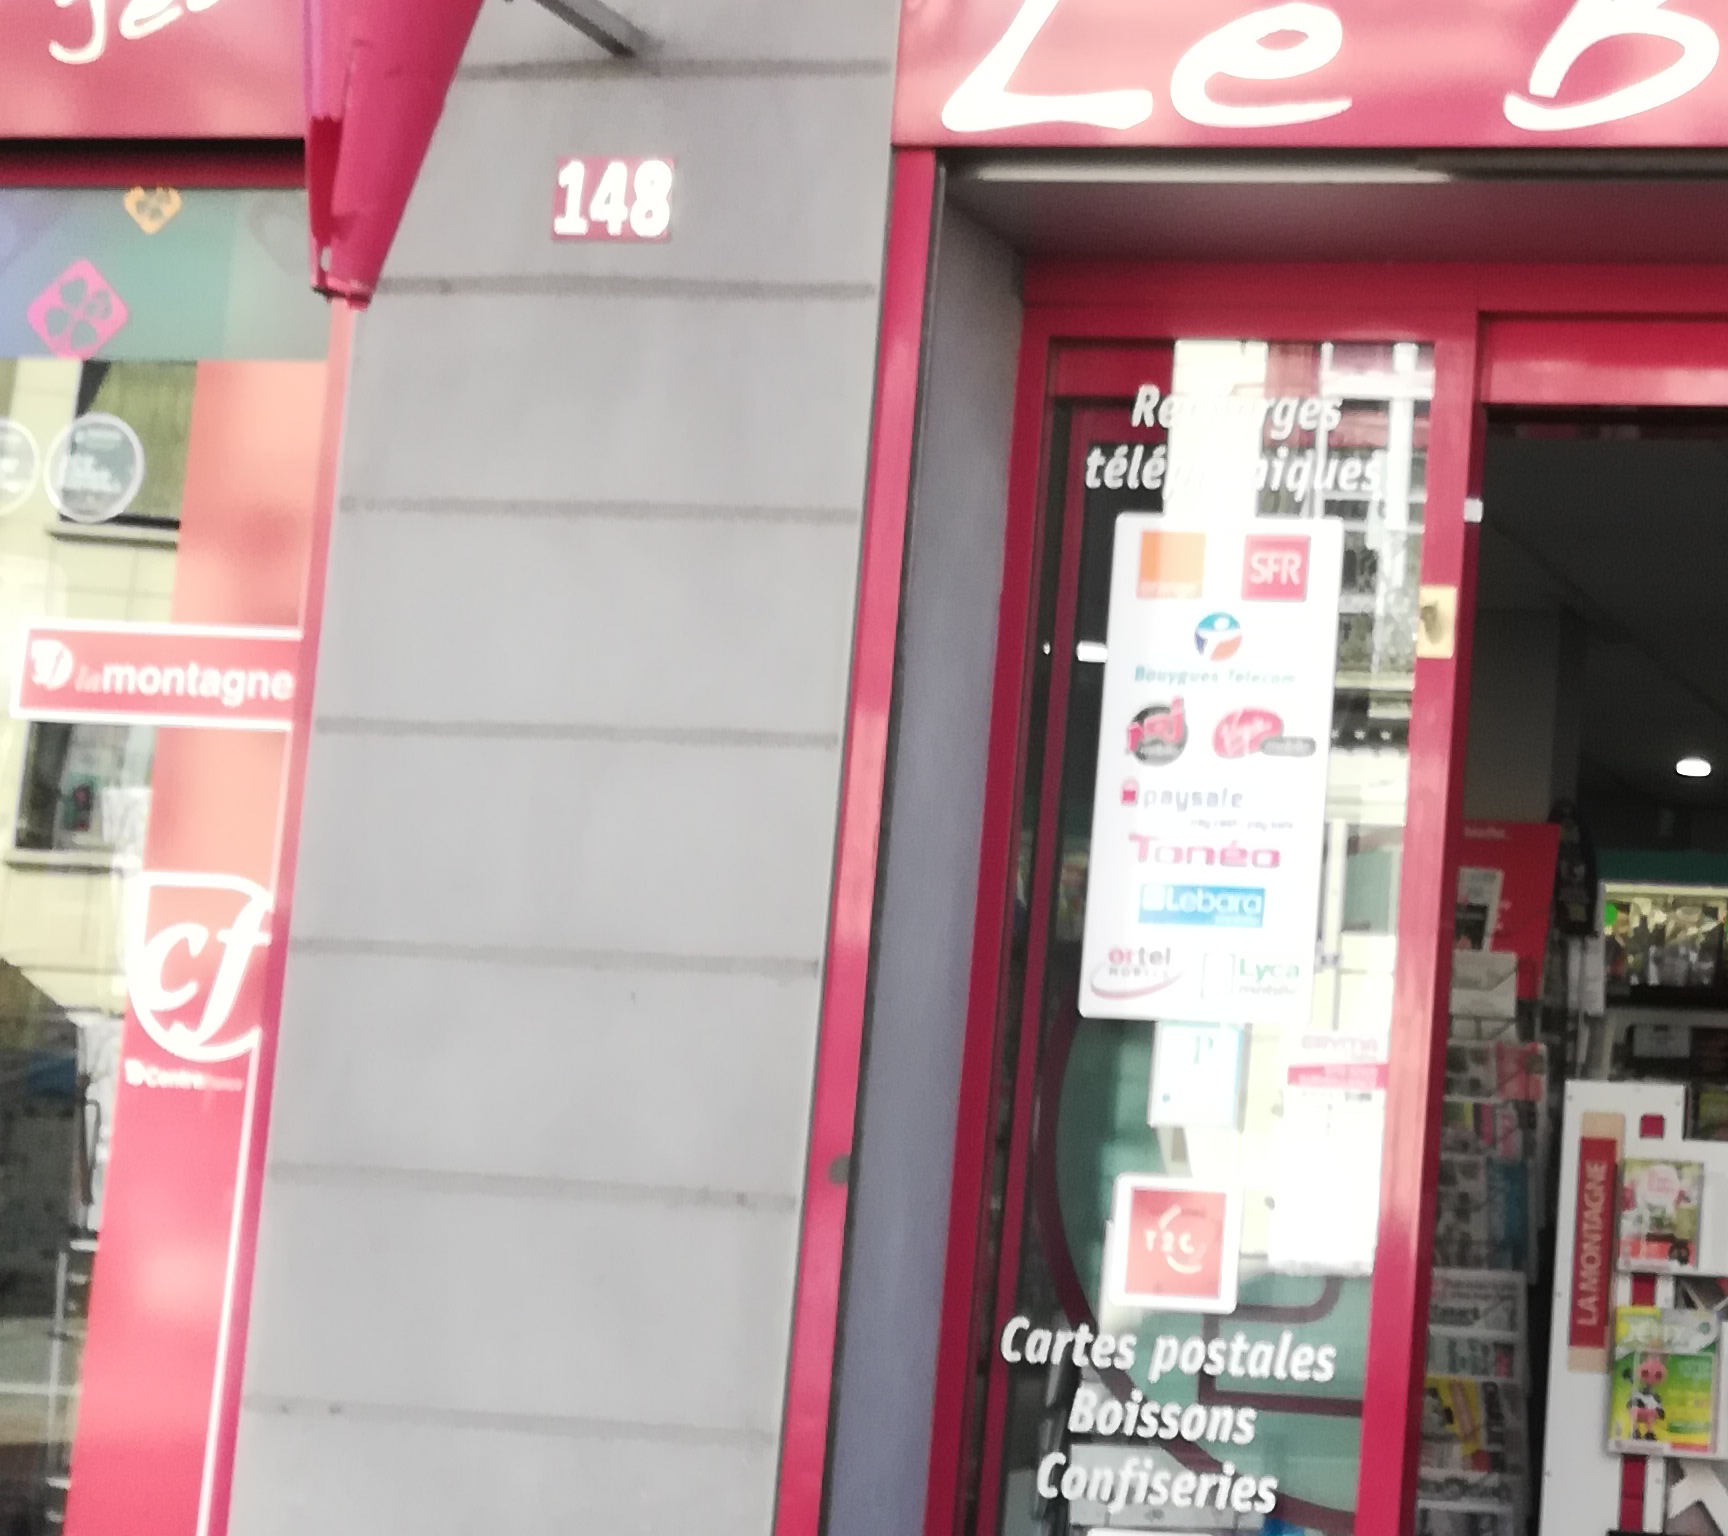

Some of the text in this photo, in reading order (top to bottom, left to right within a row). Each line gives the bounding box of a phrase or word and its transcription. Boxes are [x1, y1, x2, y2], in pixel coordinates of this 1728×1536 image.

[553, 159, 673, 237] 148
[1249, 549, 1302, 586] SFR
[101, 661, 296, 709] montagne
[1163, 885, 1263, 916] Lebara
[1144, 1230, 1197, 1256] T2C
[1575, 1159, 1608, 1292] MONTAGNE
[1000, 1315, 1338, 1383] Cartes postales
[1067, 1381, 1259, 1445] Boissons
[1036, 1451, 1280, 1514] Confiseries
